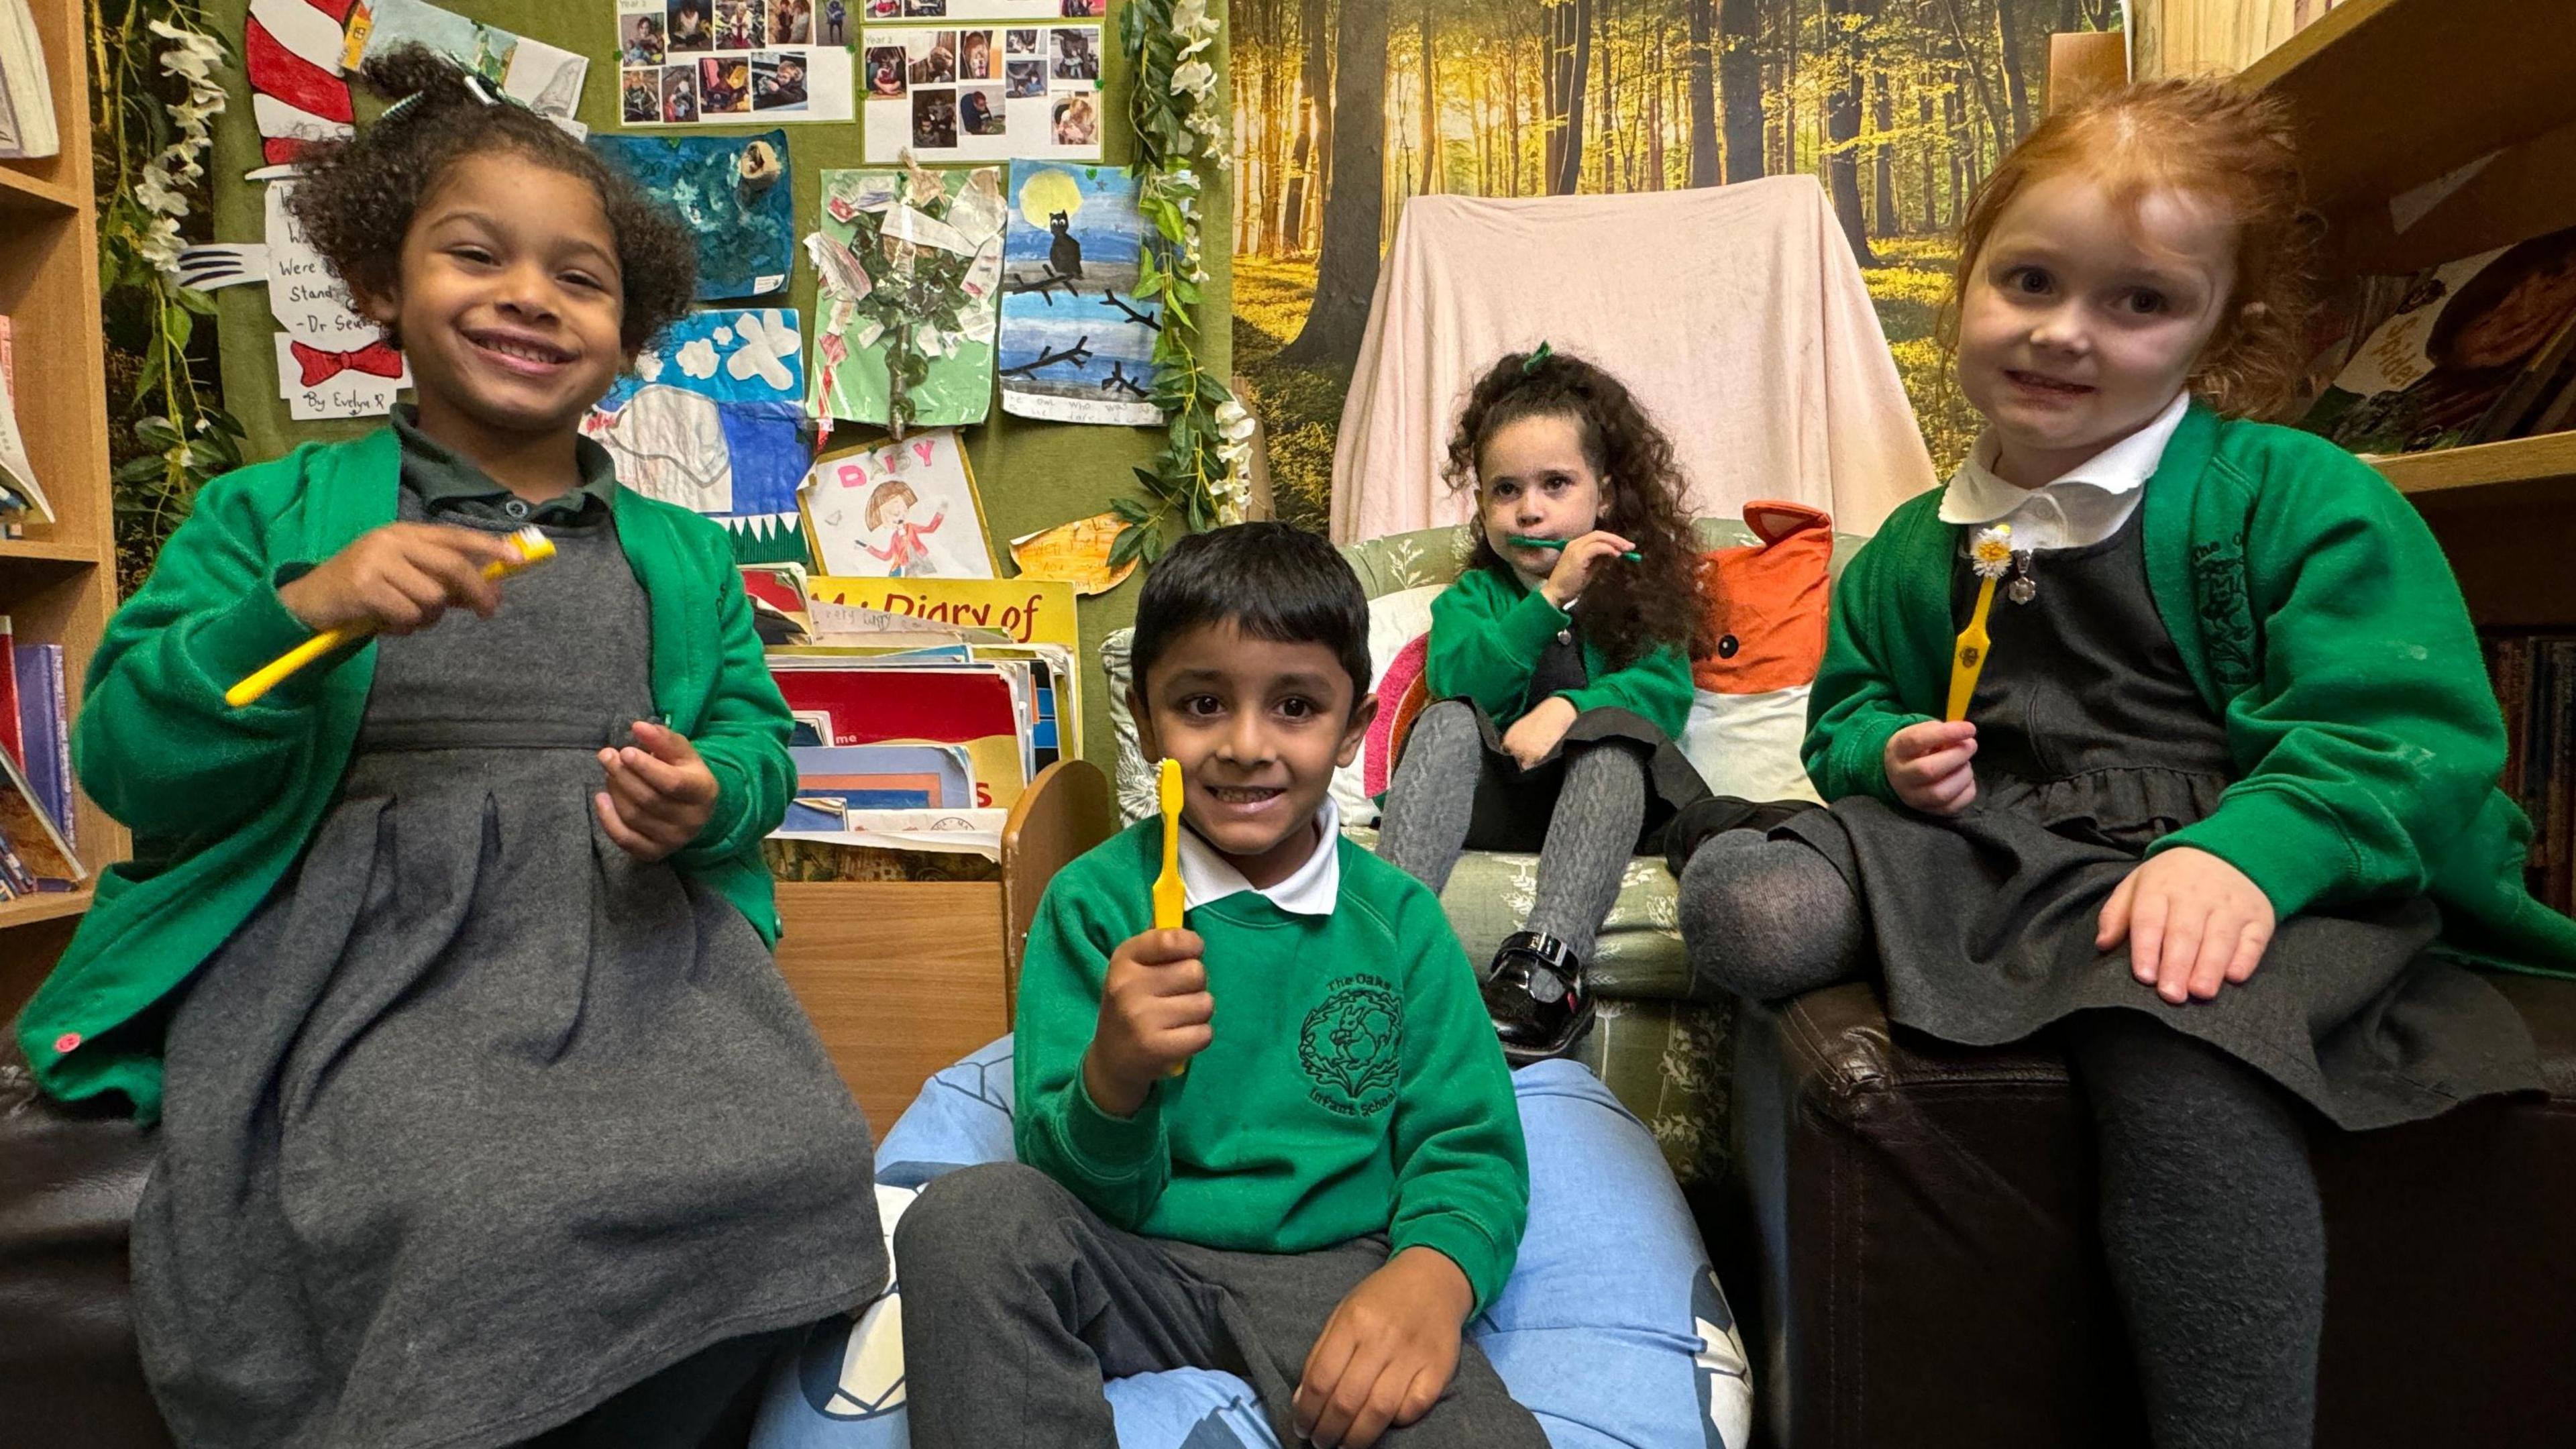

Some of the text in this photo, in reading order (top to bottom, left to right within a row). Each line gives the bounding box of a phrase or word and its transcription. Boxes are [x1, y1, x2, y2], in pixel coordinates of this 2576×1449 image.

[865, 35, 885, 44] Year
[279, 258, 315, 276] Were
[290, 285, 334, 302] Stand
[838, 440, 935, 487] DAISY
[1001, 594, 1042, 643] of
[1326, 973, 1391, 991] The Oaks
[1309, 1087, 1397, 1117] Infant School
